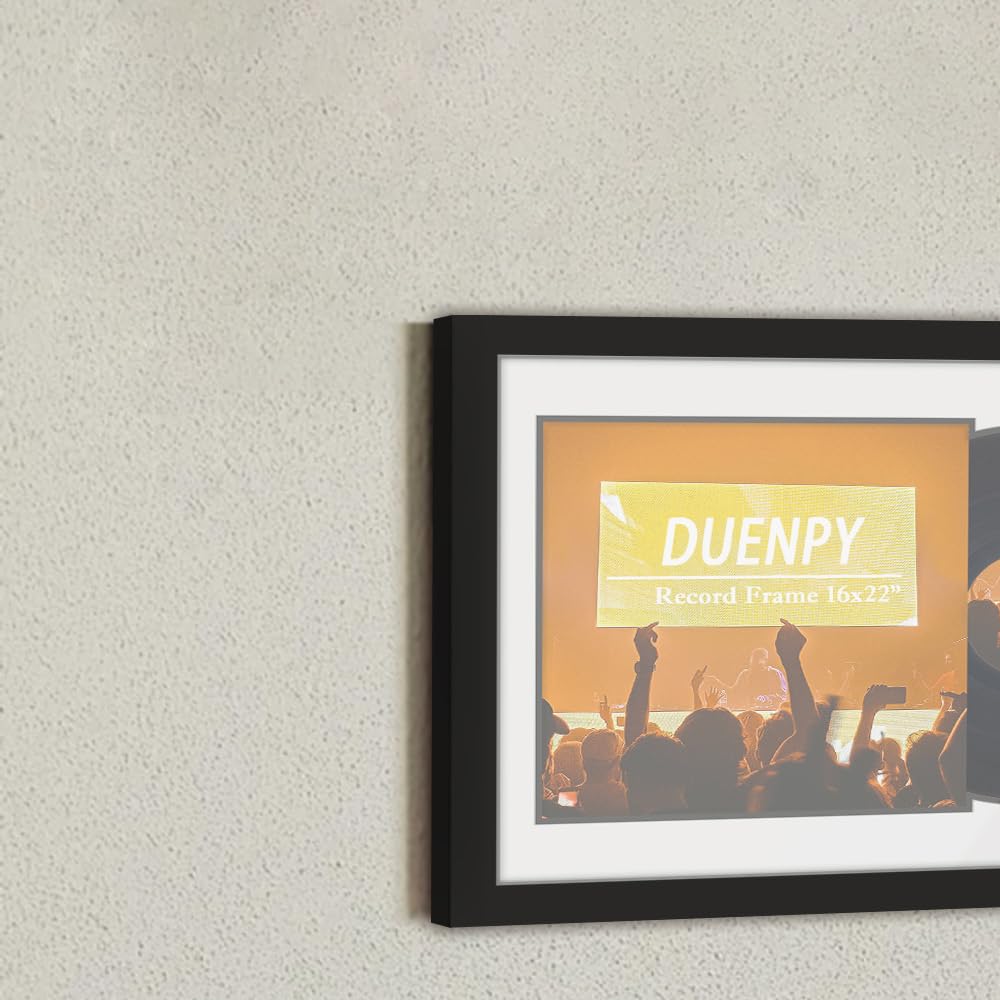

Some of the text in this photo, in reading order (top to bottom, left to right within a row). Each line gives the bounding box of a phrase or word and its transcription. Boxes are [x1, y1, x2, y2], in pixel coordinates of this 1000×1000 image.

[661, 516, 866, 566] DUENPY
[654, 586, 737, 605] Record
[746, 586, 819, 604] Frame
